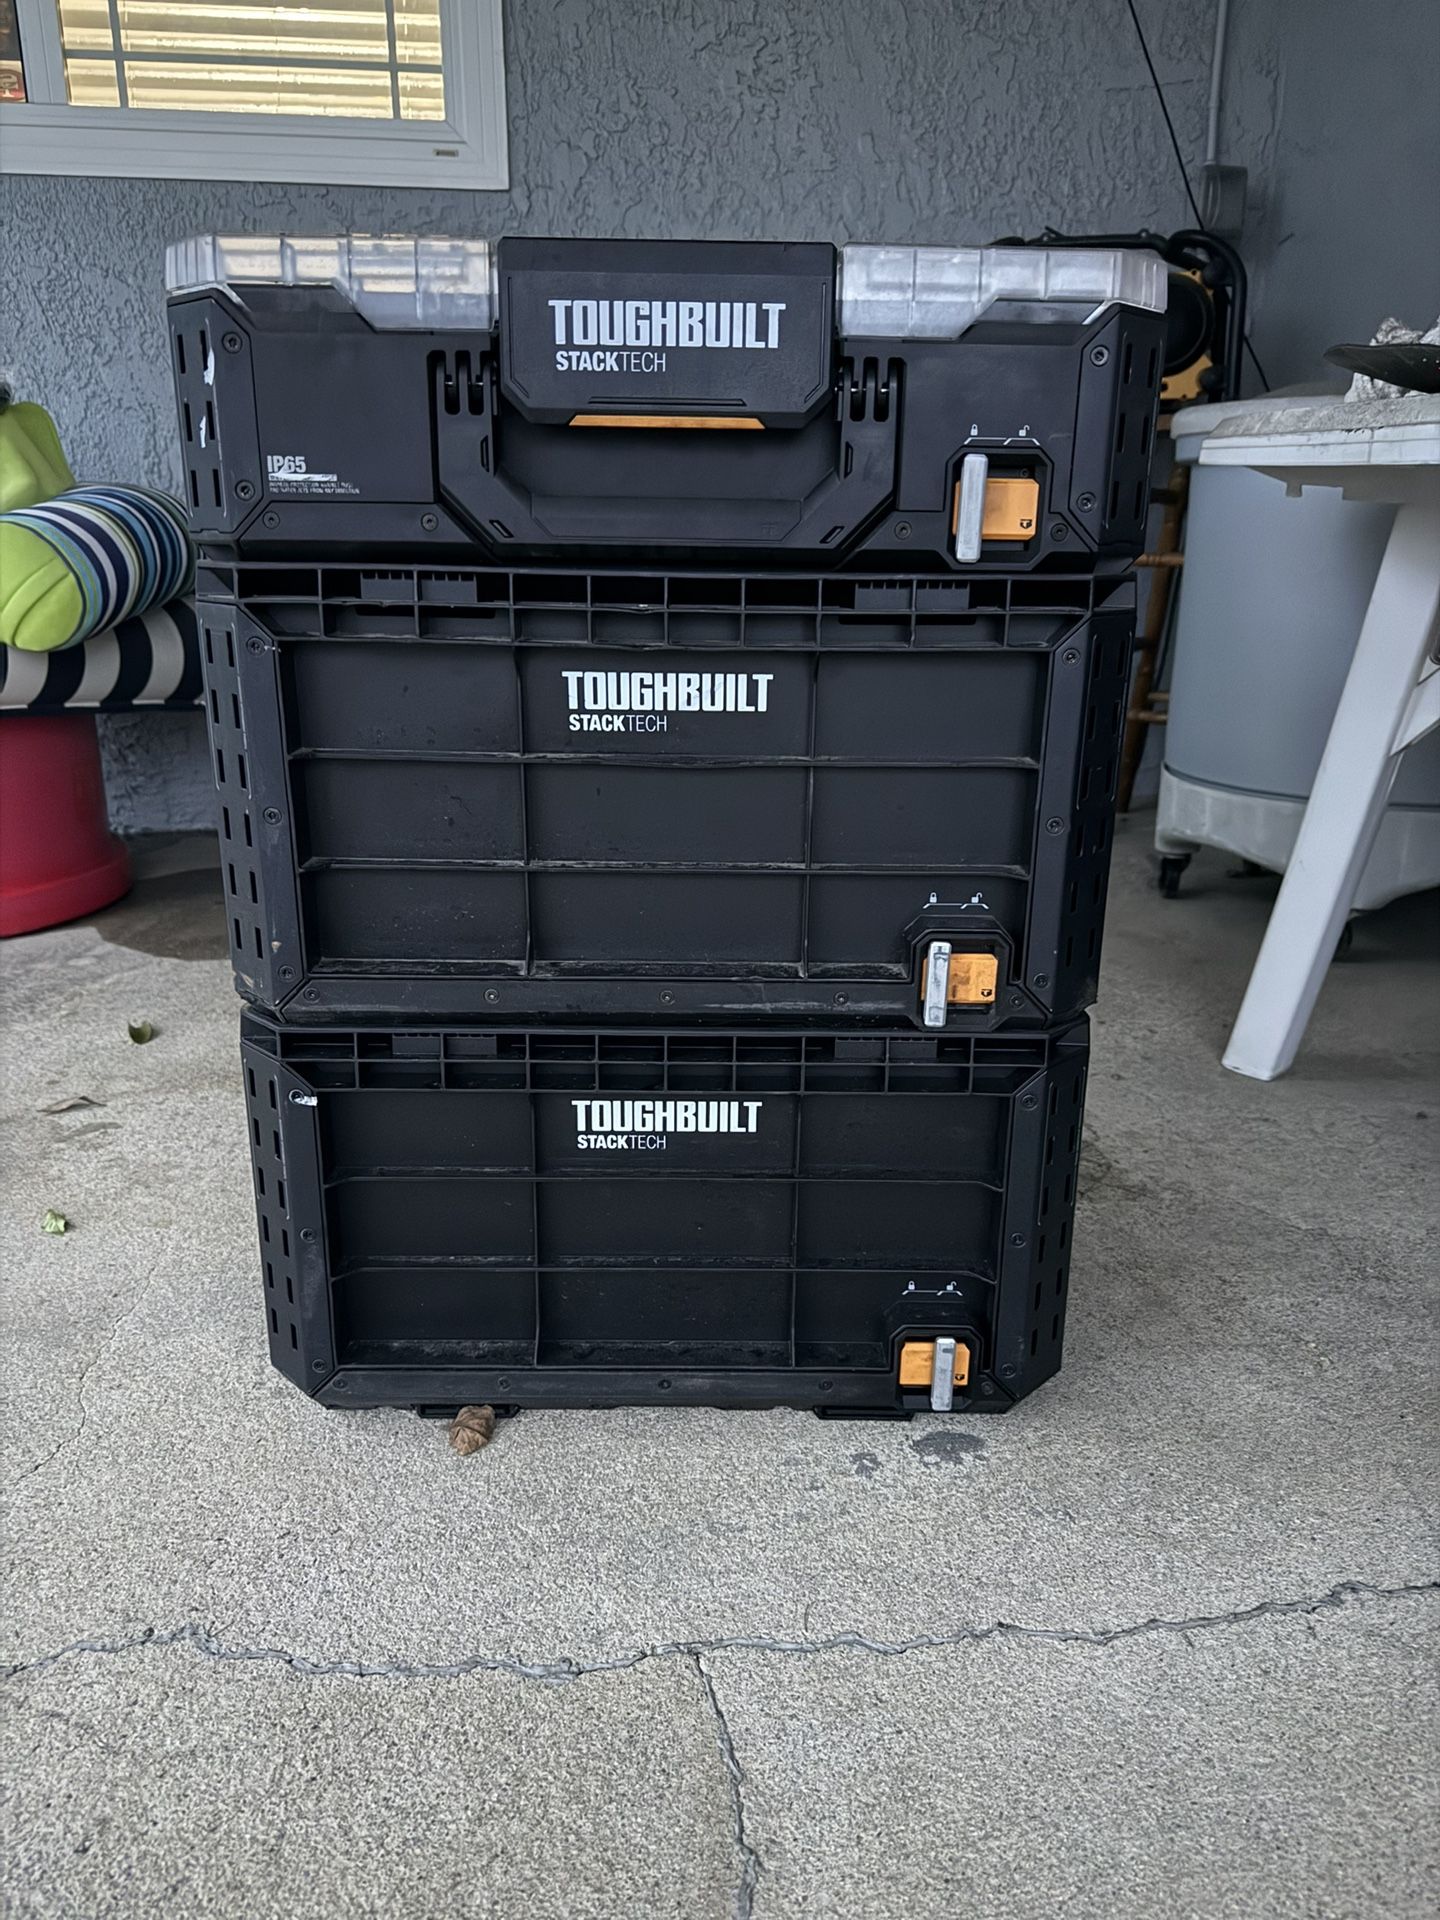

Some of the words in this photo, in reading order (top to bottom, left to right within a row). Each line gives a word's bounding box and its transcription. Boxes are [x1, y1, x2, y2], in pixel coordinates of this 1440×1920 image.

[548, 299, 786, 349] TOUGHBUILT
[556, 351, 666, 373] STACKTECH
[267, 455, 306, 473] IP65
[562, 671, 773, 712] TOUGHBUILT
[569, 714, 667, 732] STACKTECH
[572, 1100, 762, 1133] TOUGHBUILT
[577, 1135, 667, 1150] STACKTECH
